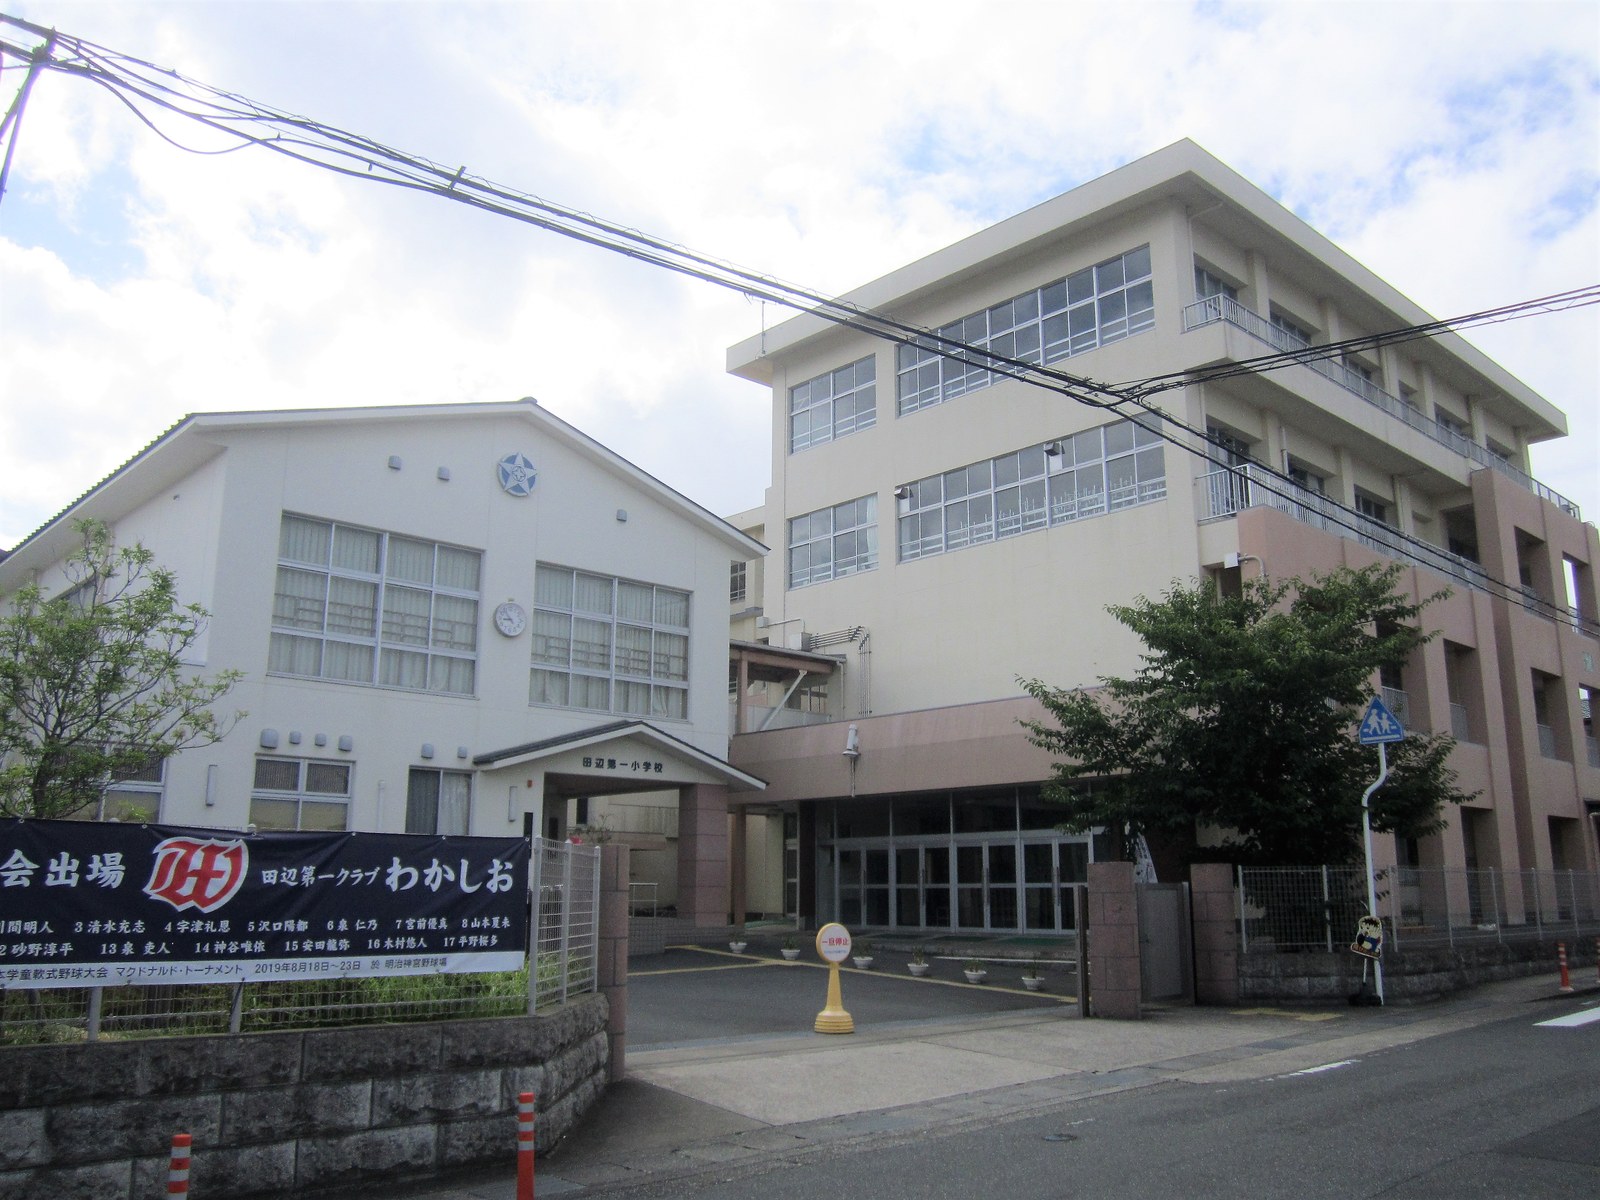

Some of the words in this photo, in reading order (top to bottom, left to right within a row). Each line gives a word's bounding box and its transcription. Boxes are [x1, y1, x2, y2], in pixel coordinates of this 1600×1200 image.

[582, 757, 663, 773] 田辺第一小学校
[1, 848, 126, 889] 会出場
[261, 865, 380, 887] 田辺第一クラブ
[385, 856, 513, 894] わかしお
[74, 921, 83, 933] 3
[164, 921, 172, 933] 4
[248, 921, 255, 932] 5
[327, 920, 334, 930] 6
[395, 919, 402, 929] 7
[461, 918, 468, 928] 8
[100, 943, 117, 955] 13
[194, 942, 210, 953] 14
[285, 940, 299, 951] 15
[367, 939, 380, 949] 16
[443, 937, 455, 947] 17
